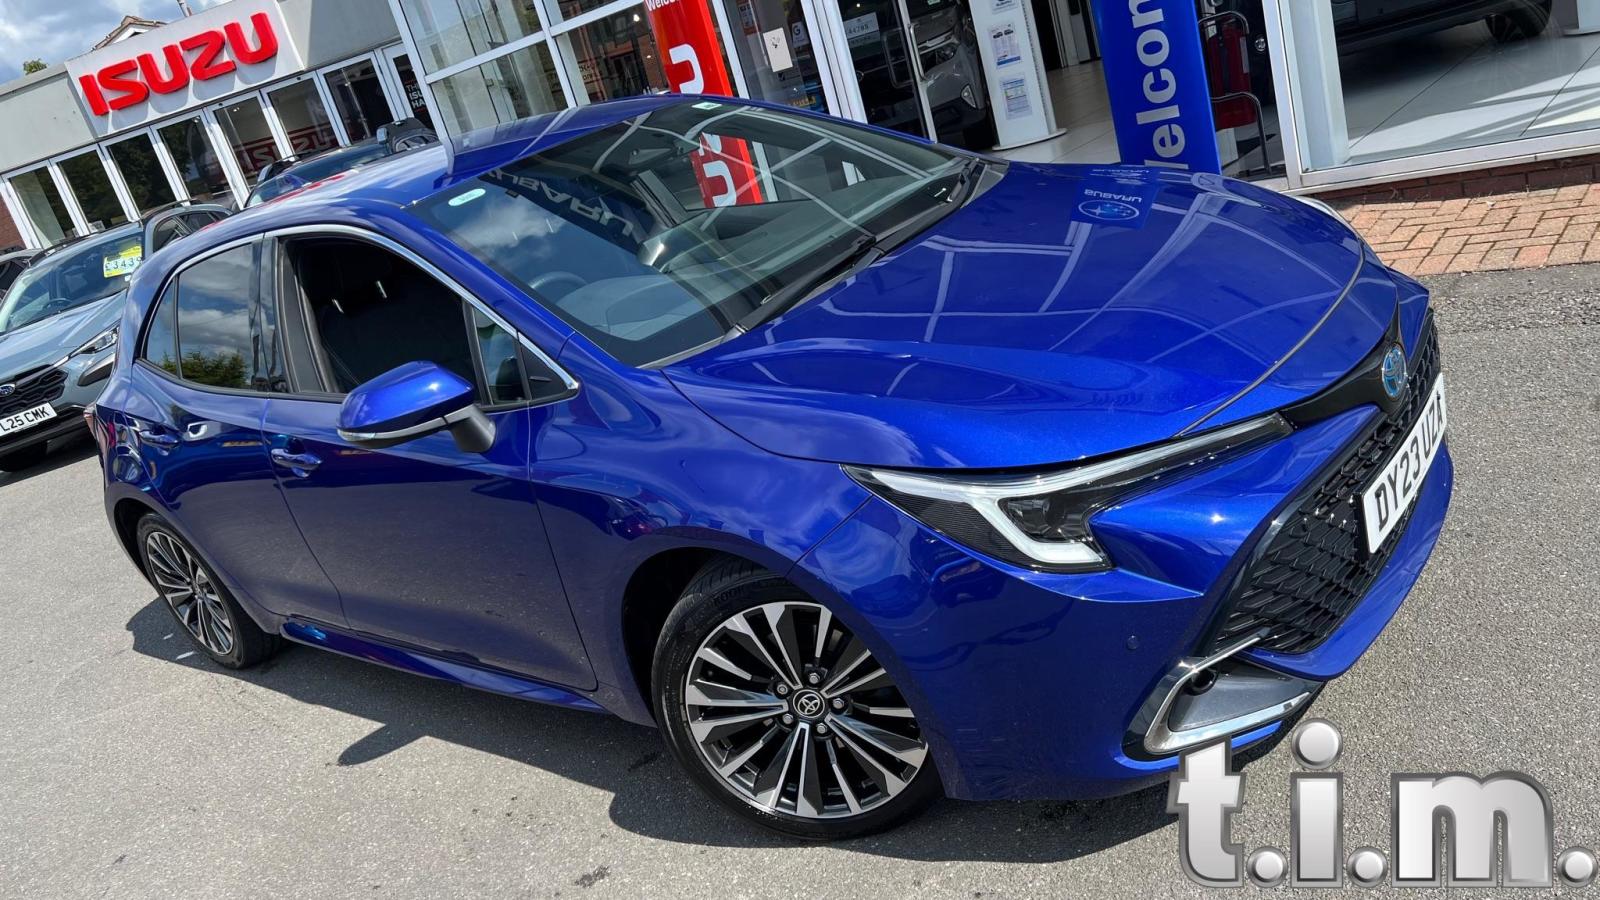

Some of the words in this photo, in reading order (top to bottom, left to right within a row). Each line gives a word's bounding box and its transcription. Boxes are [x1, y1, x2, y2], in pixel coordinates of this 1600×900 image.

[79, 12, 279, 116] ISUZU
[24, 406, 50, 423] CMK
[1374, 436, 1421, 532] DY23
[1422, 392, 1444, 459] UZA
